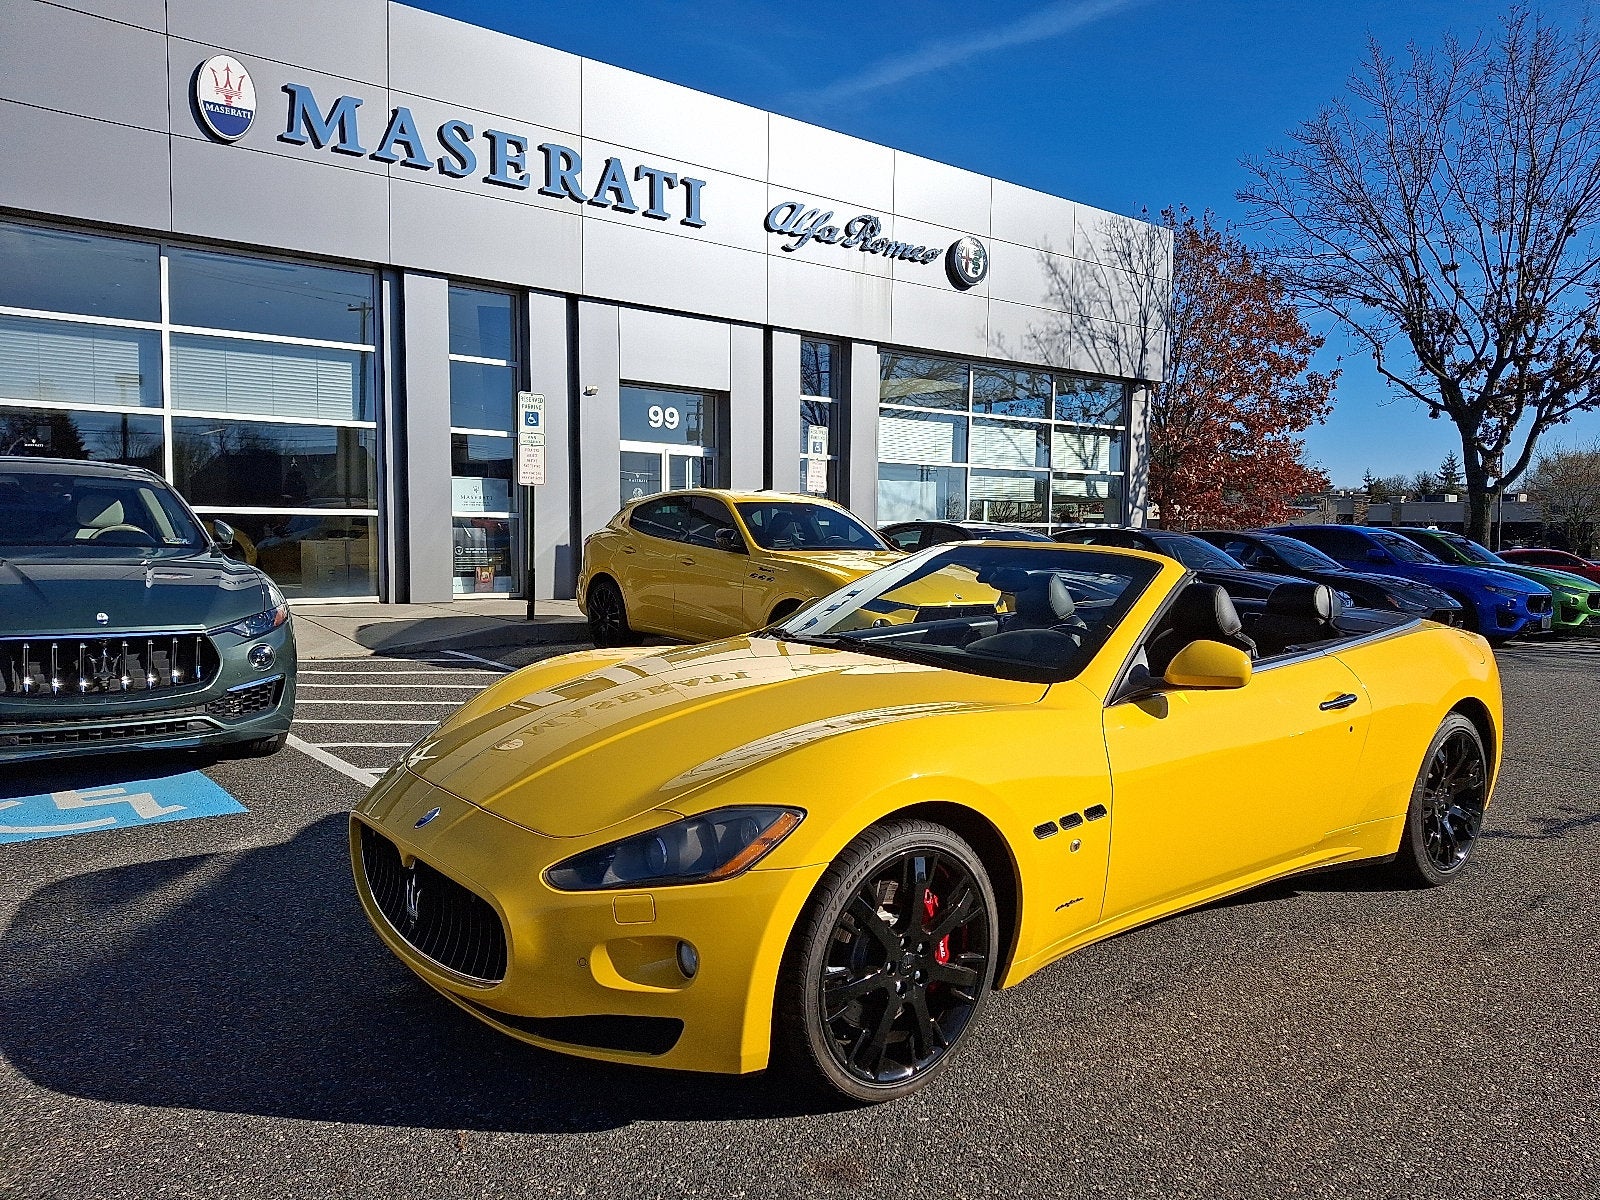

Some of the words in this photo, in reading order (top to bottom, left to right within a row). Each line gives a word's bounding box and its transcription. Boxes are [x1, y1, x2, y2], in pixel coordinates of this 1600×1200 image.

[205, 102, 251, 119] MASERATI
[278, 82, 706, 228] MASERATI
[764, 201, 840, 251] Alfa
[840, 215, 943, 264] Romeo
[648, 405, 679, 429] 99
